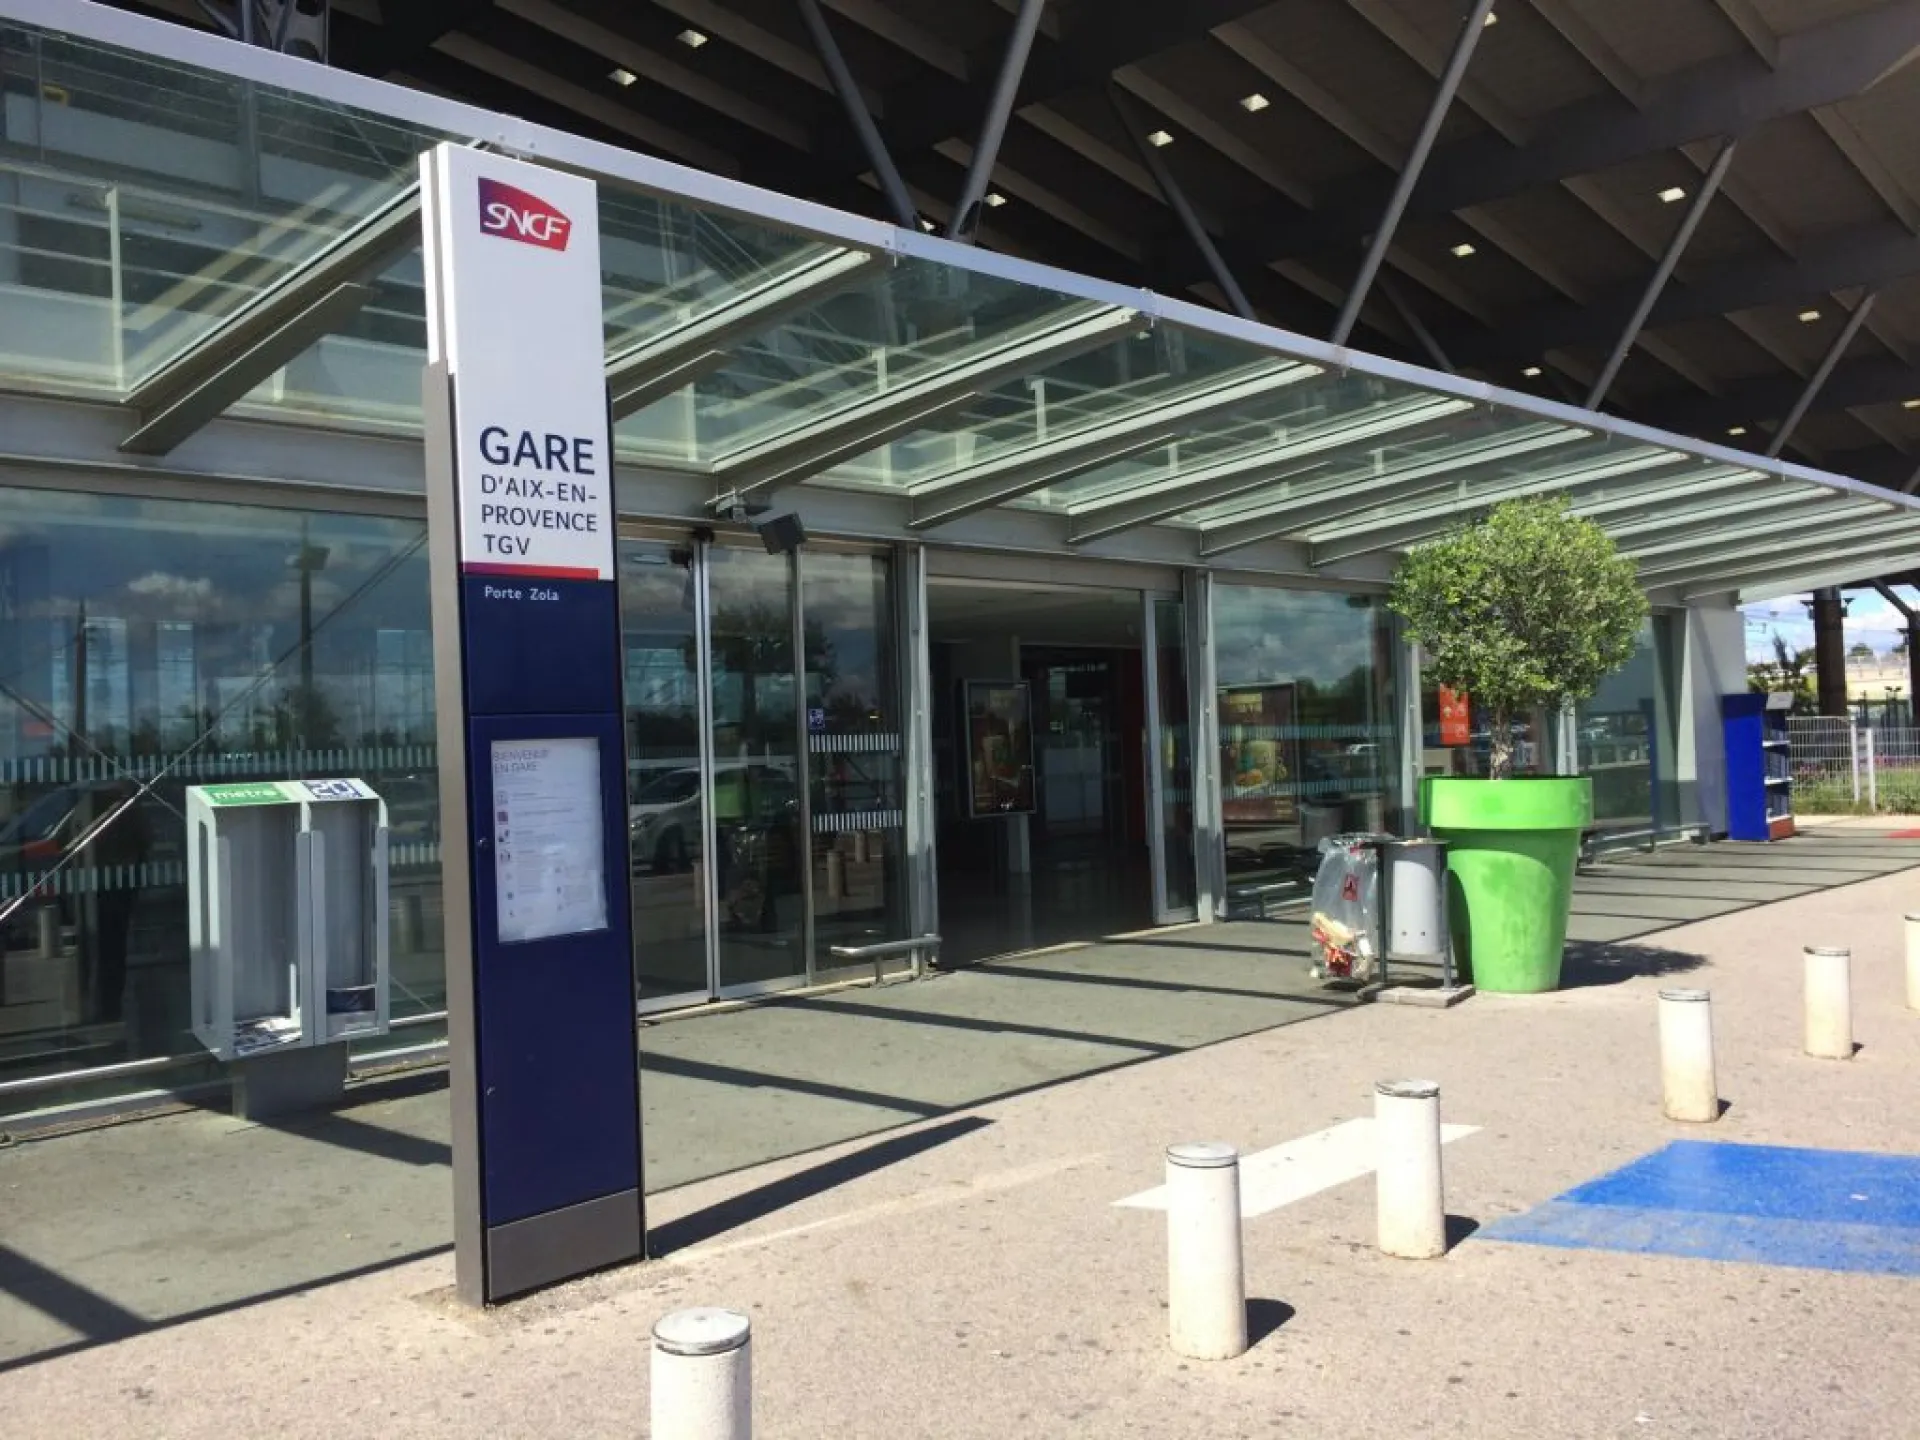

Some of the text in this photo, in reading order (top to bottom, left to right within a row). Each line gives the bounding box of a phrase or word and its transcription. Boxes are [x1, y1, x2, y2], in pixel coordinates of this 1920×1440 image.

[484, 203, 567, 240] SNCF
[480, 427, 595, 475] GARE
[481, 474, 597, 503] D'AIX-EN-
[481, 504, 598, 533] PROVENCE
[484, 534, 530, 556] TGV
[484, 585, 560, 601] Porte Zola
